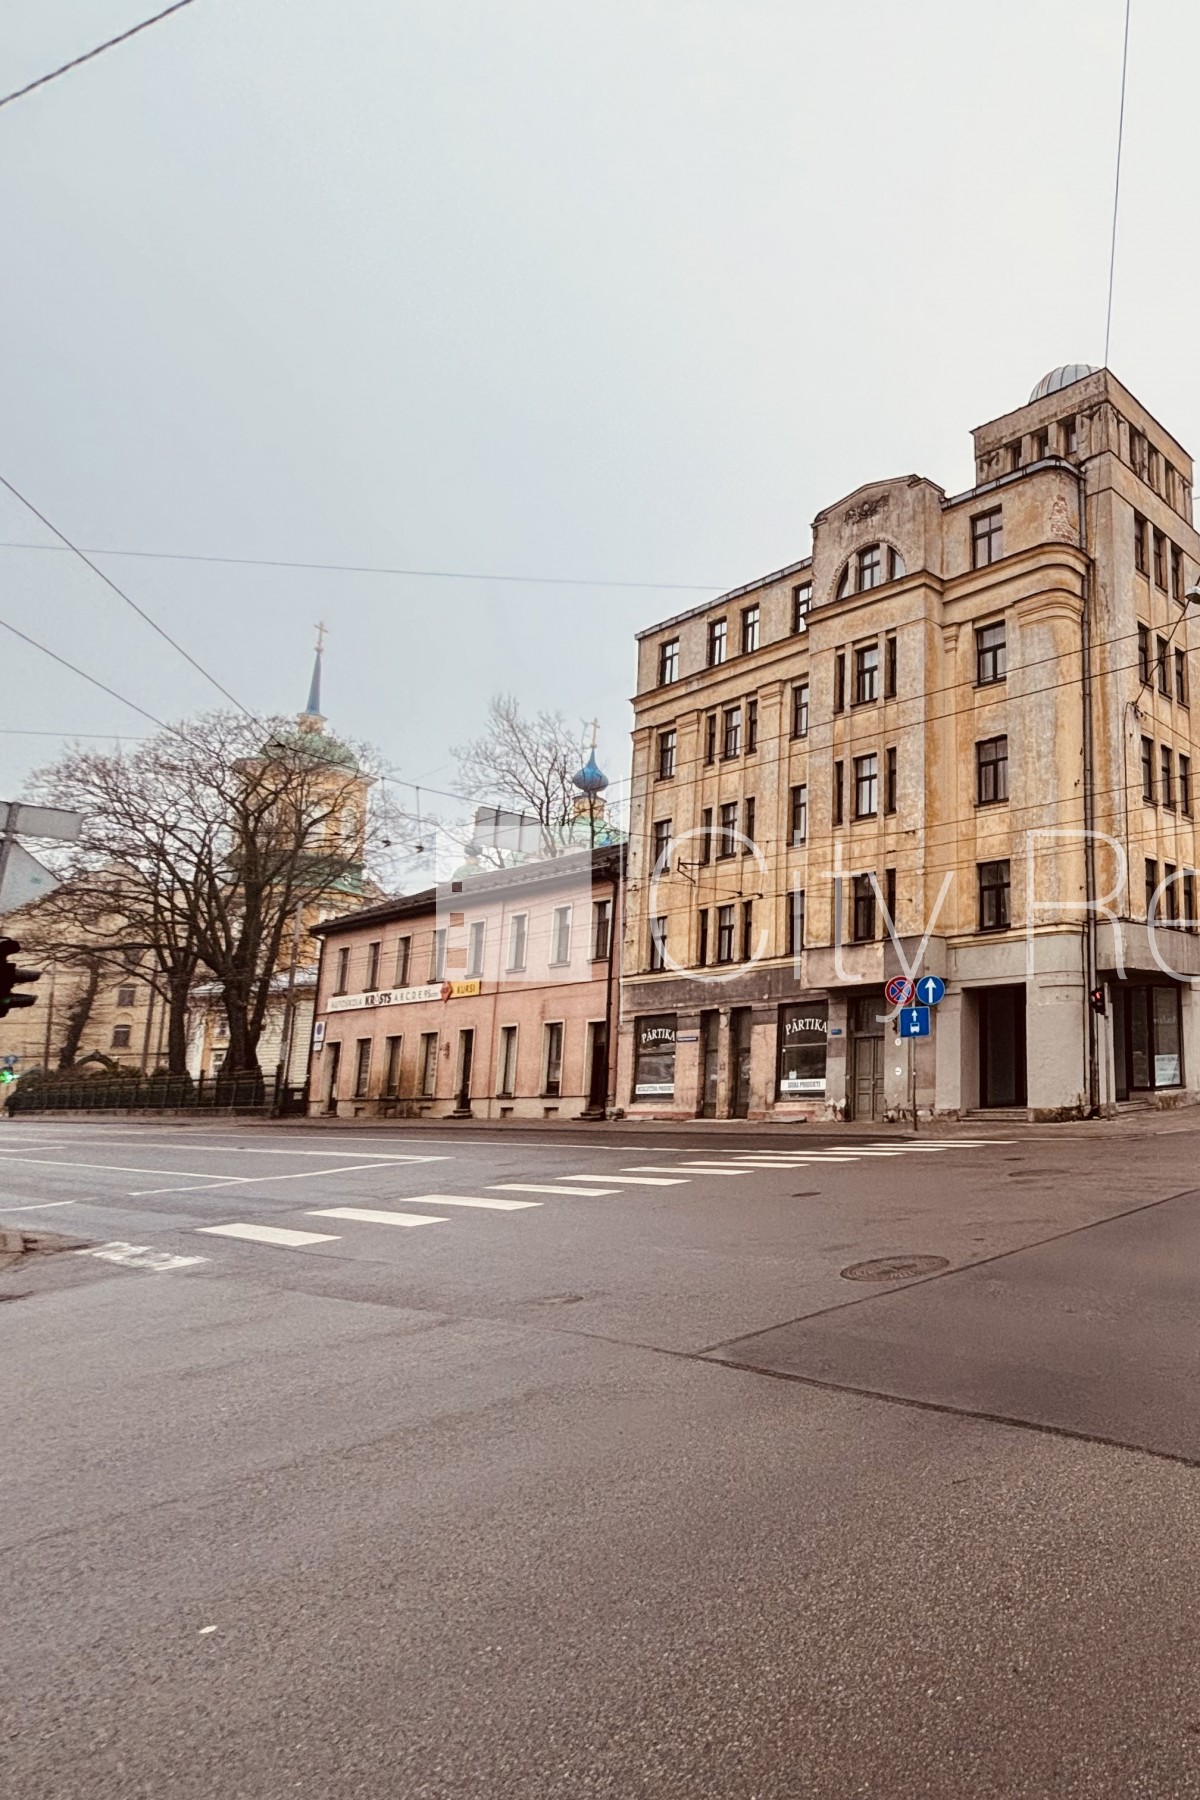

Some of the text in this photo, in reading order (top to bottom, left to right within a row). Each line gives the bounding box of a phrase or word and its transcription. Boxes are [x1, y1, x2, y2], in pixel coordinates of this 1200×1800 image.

[456, 984, 476, 994] KURSI
[785, 1018, 828, 1036] PĀRTIKA
[641, 1028, 675, 1044] PĀRTIKA
